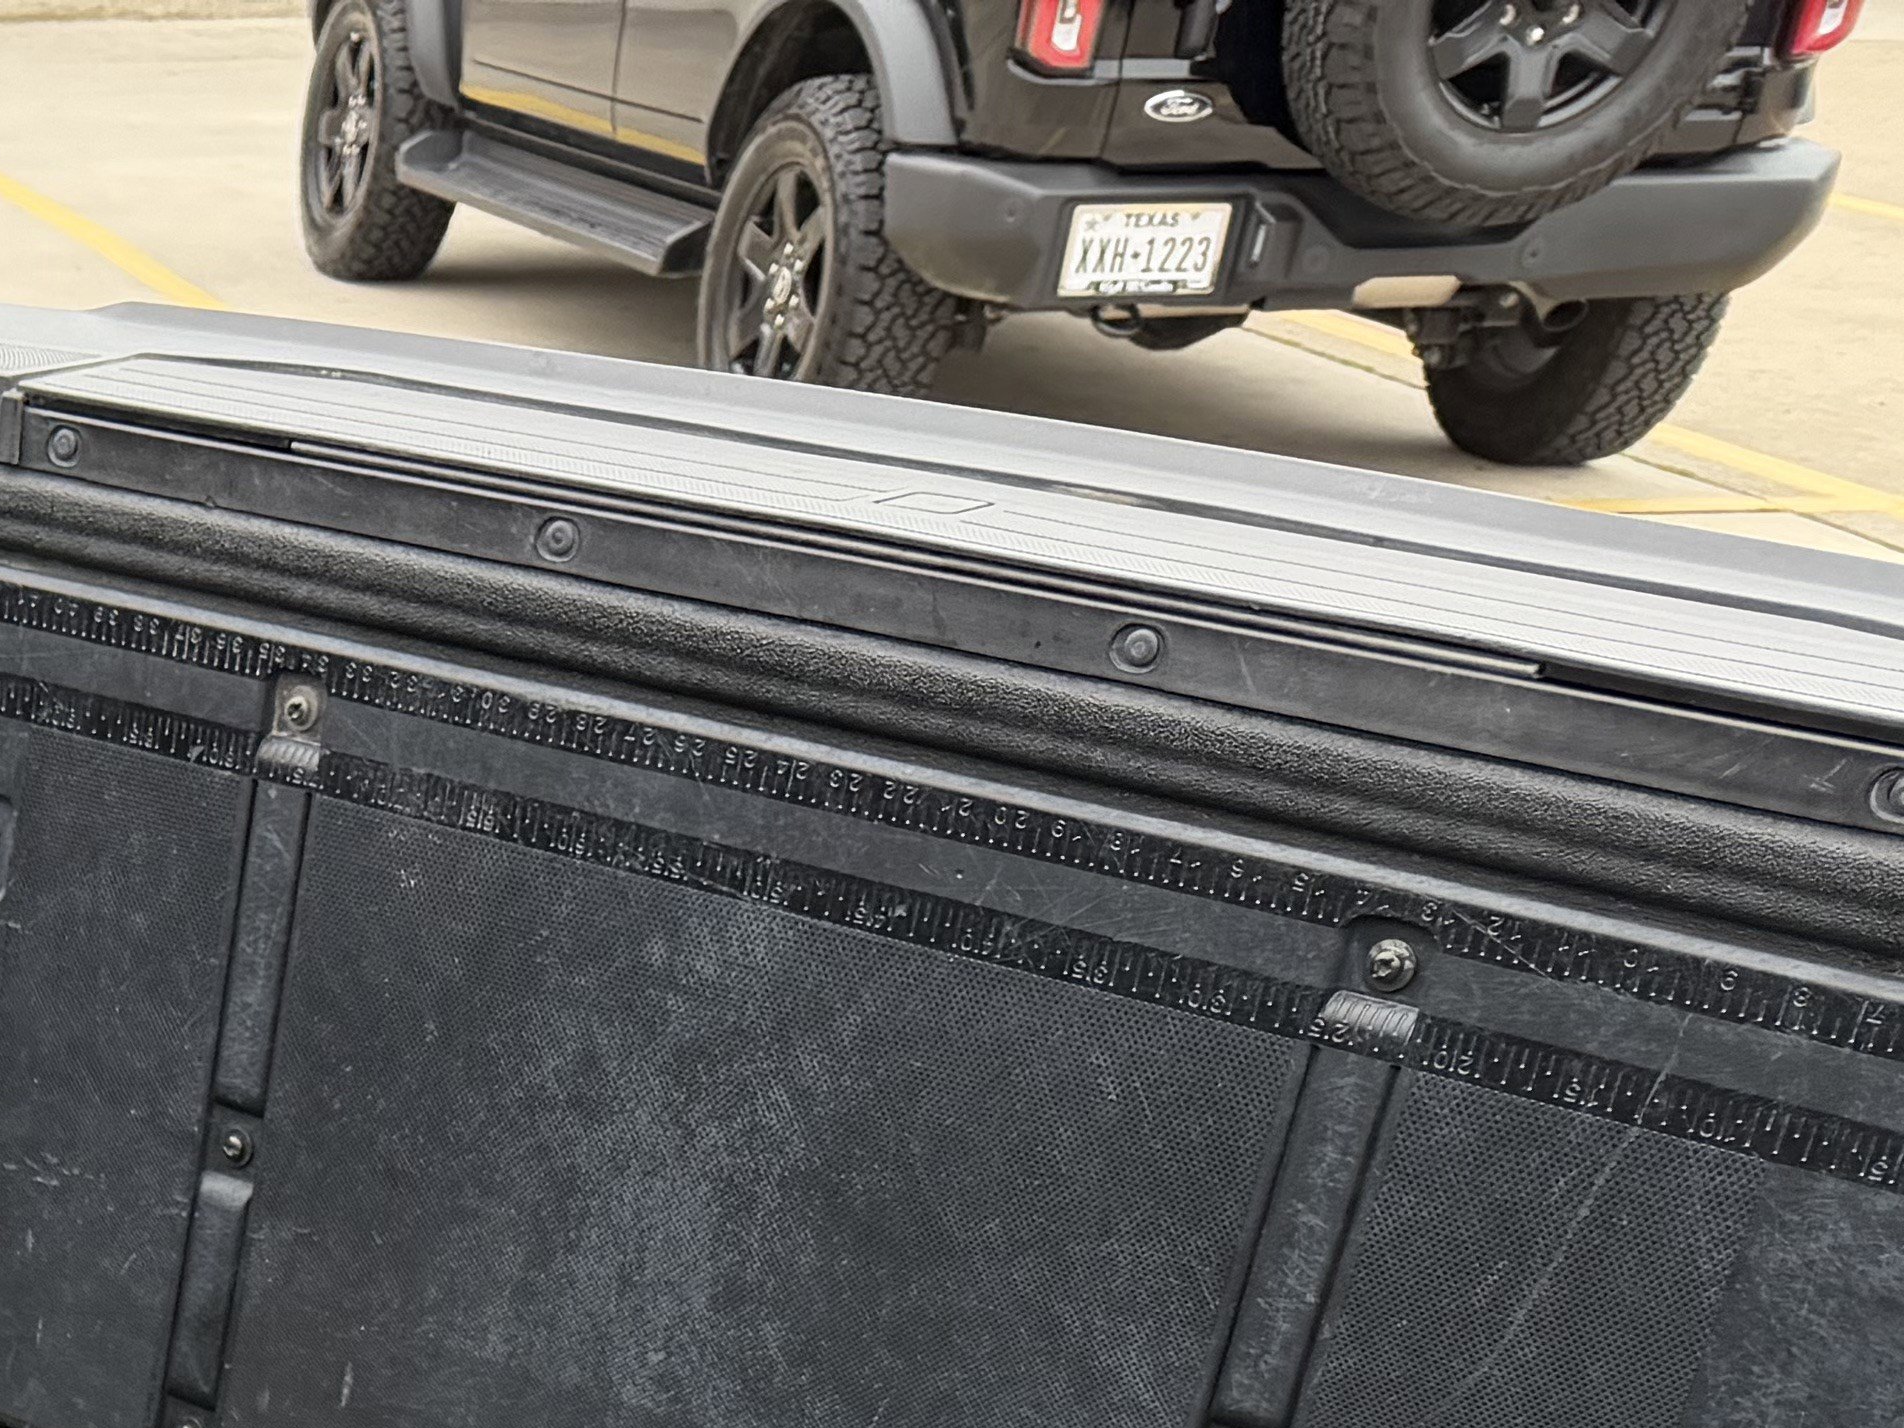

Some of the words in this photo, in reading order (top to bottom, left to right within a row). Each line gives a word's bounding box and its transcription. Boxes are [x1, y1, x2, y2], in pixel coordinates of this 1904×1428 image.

[1124, 212, 1180, 228] TEXAS
[174, 623, 201, 643] 37
[216, 633, 243, 653] 36
[258, 641, 285, 662] 35
[345, 661, 372, 682] 33
[390, 671, 417, 692] 32
[480, 691, 510, 712] 30
[527, 701, 556, 723] 29
[575, 712, 606, 734] 28
[623, 723, 654, 744] 27
[673, 734, 705, 756] 26
[724, 746, 757, 767] 25
[776, 758, 809, 779] 24
[829, 769, 862, 791] 23
[882, 781, 917, 803] 22
[941, 794, 972, 816] 21
[993, 805, 1029, 828] 20
[1050, 819, 1081, 840] 19
[1169, 845, 1201, 867] 17
[1292, 872, 1324, 895] 15
[1421, 902, 1455, 925] 13
[1487, 915, 1521, 940] 12
[1071, 960, 1107, 983] 35
[1720, 969, 1738, 991] 9
[1187, 988, 1225, 1013] 30
[1793, 986, 1811, 1008] 8
[1866, 1002, 1884, 1023] 7
[1307, 1016, 1348, 1043] 25
[1433, 1050, 1473, 1074] 20
[1562, 1082, 1597, 1106] 15
[1699, 1118, 1735, 1142] 10
[1867, 1160, 1888, 1181] 5
